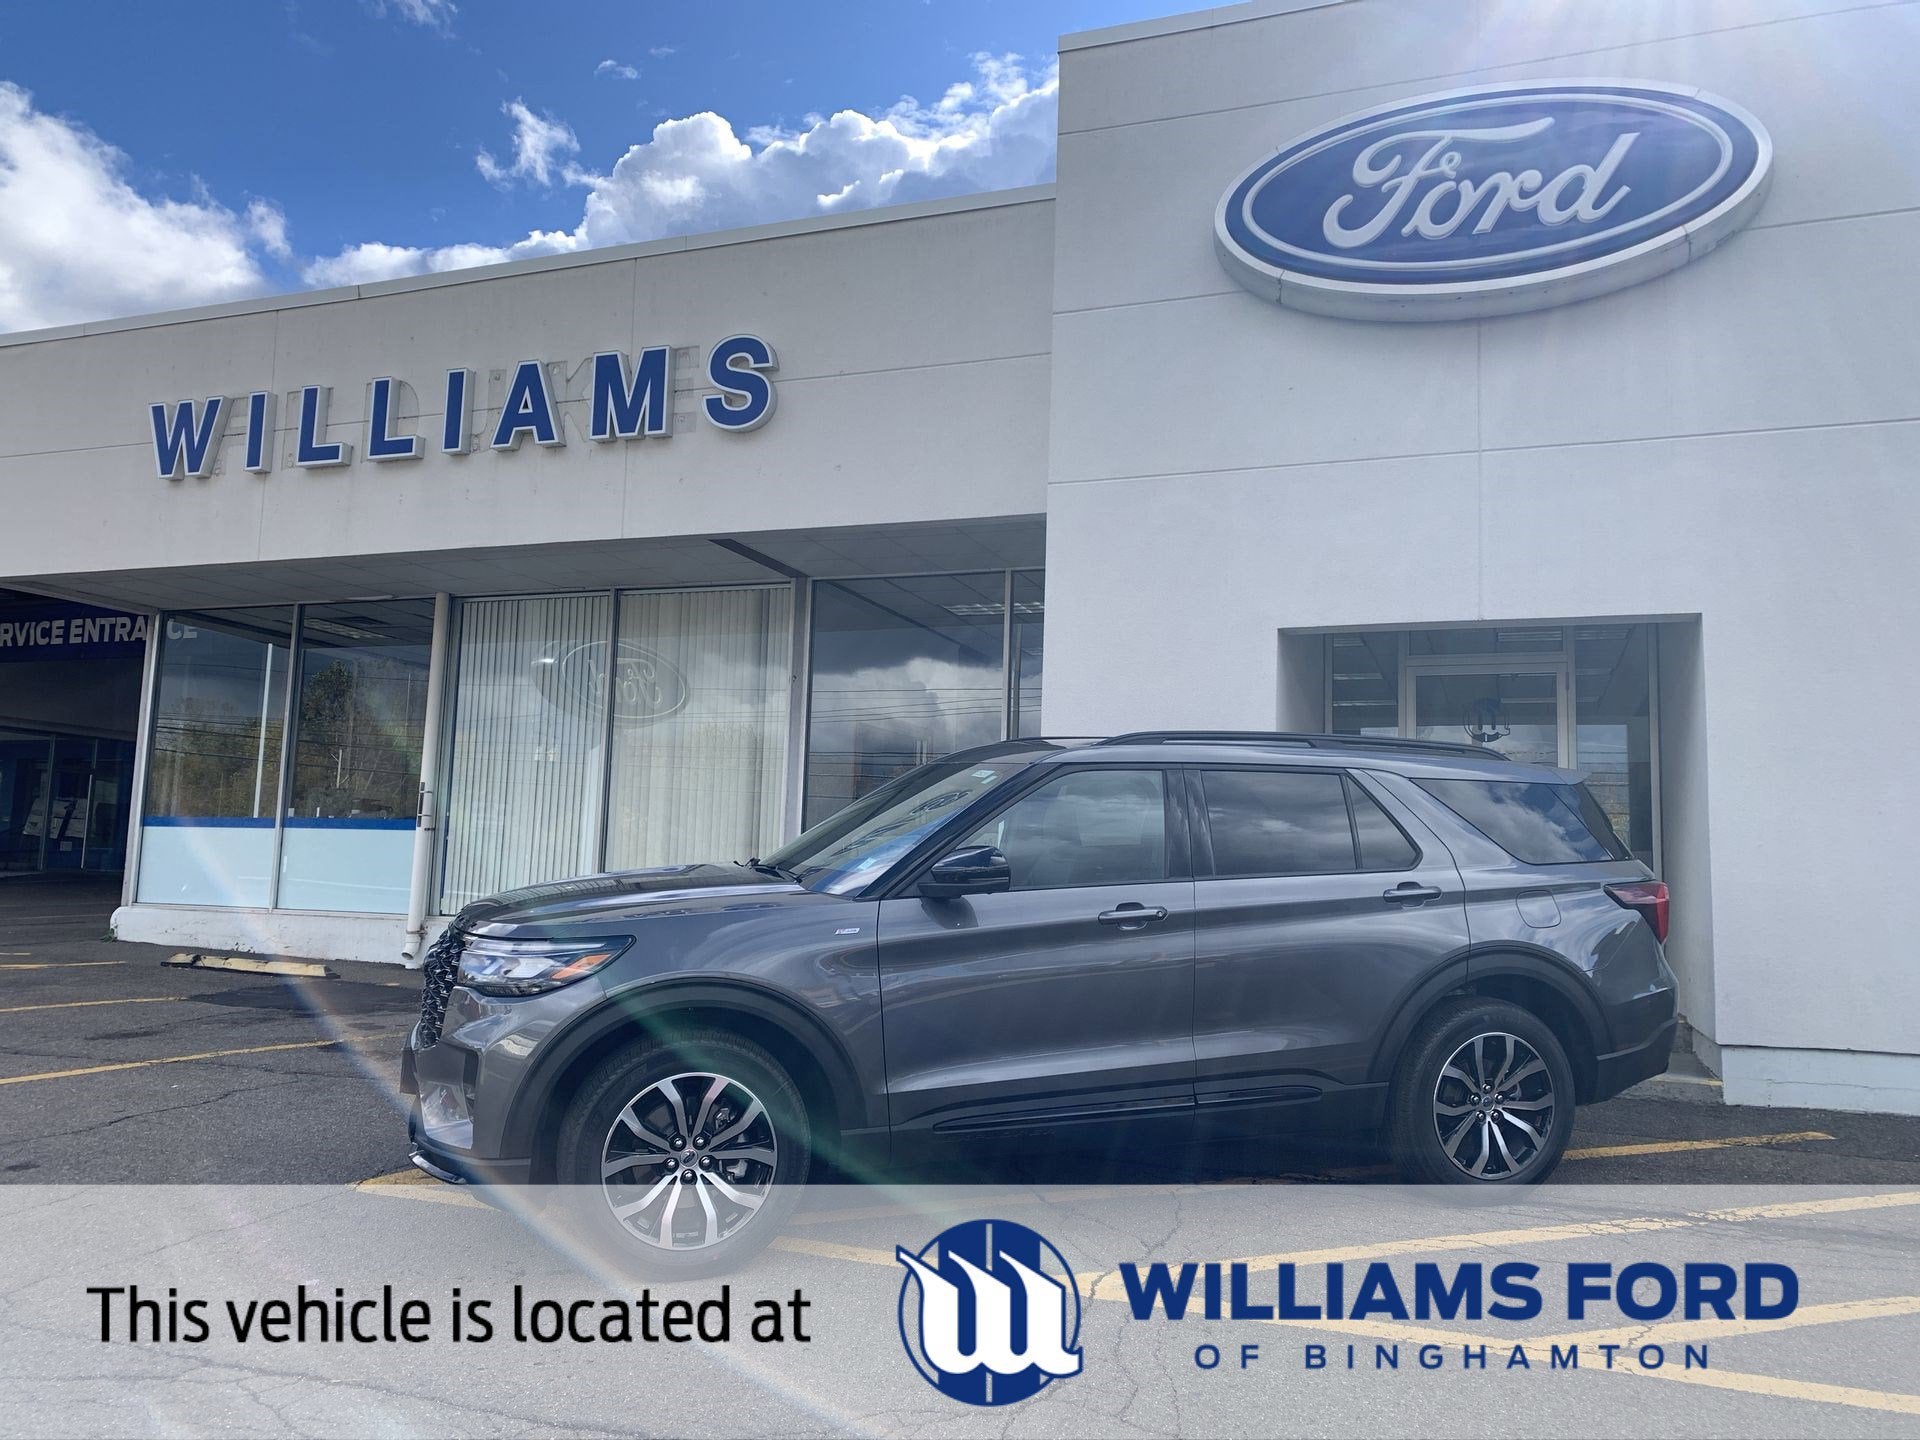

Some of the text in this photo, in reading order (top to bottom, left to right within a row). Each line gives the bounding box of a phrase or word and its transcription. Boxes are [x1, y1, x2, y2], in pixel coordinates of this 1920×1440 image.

[1323, 116, 1640, 249] Ford
[148, 333, 779, 482] WILLIAMS
[69, 615, 198, 644] ENTRACE
